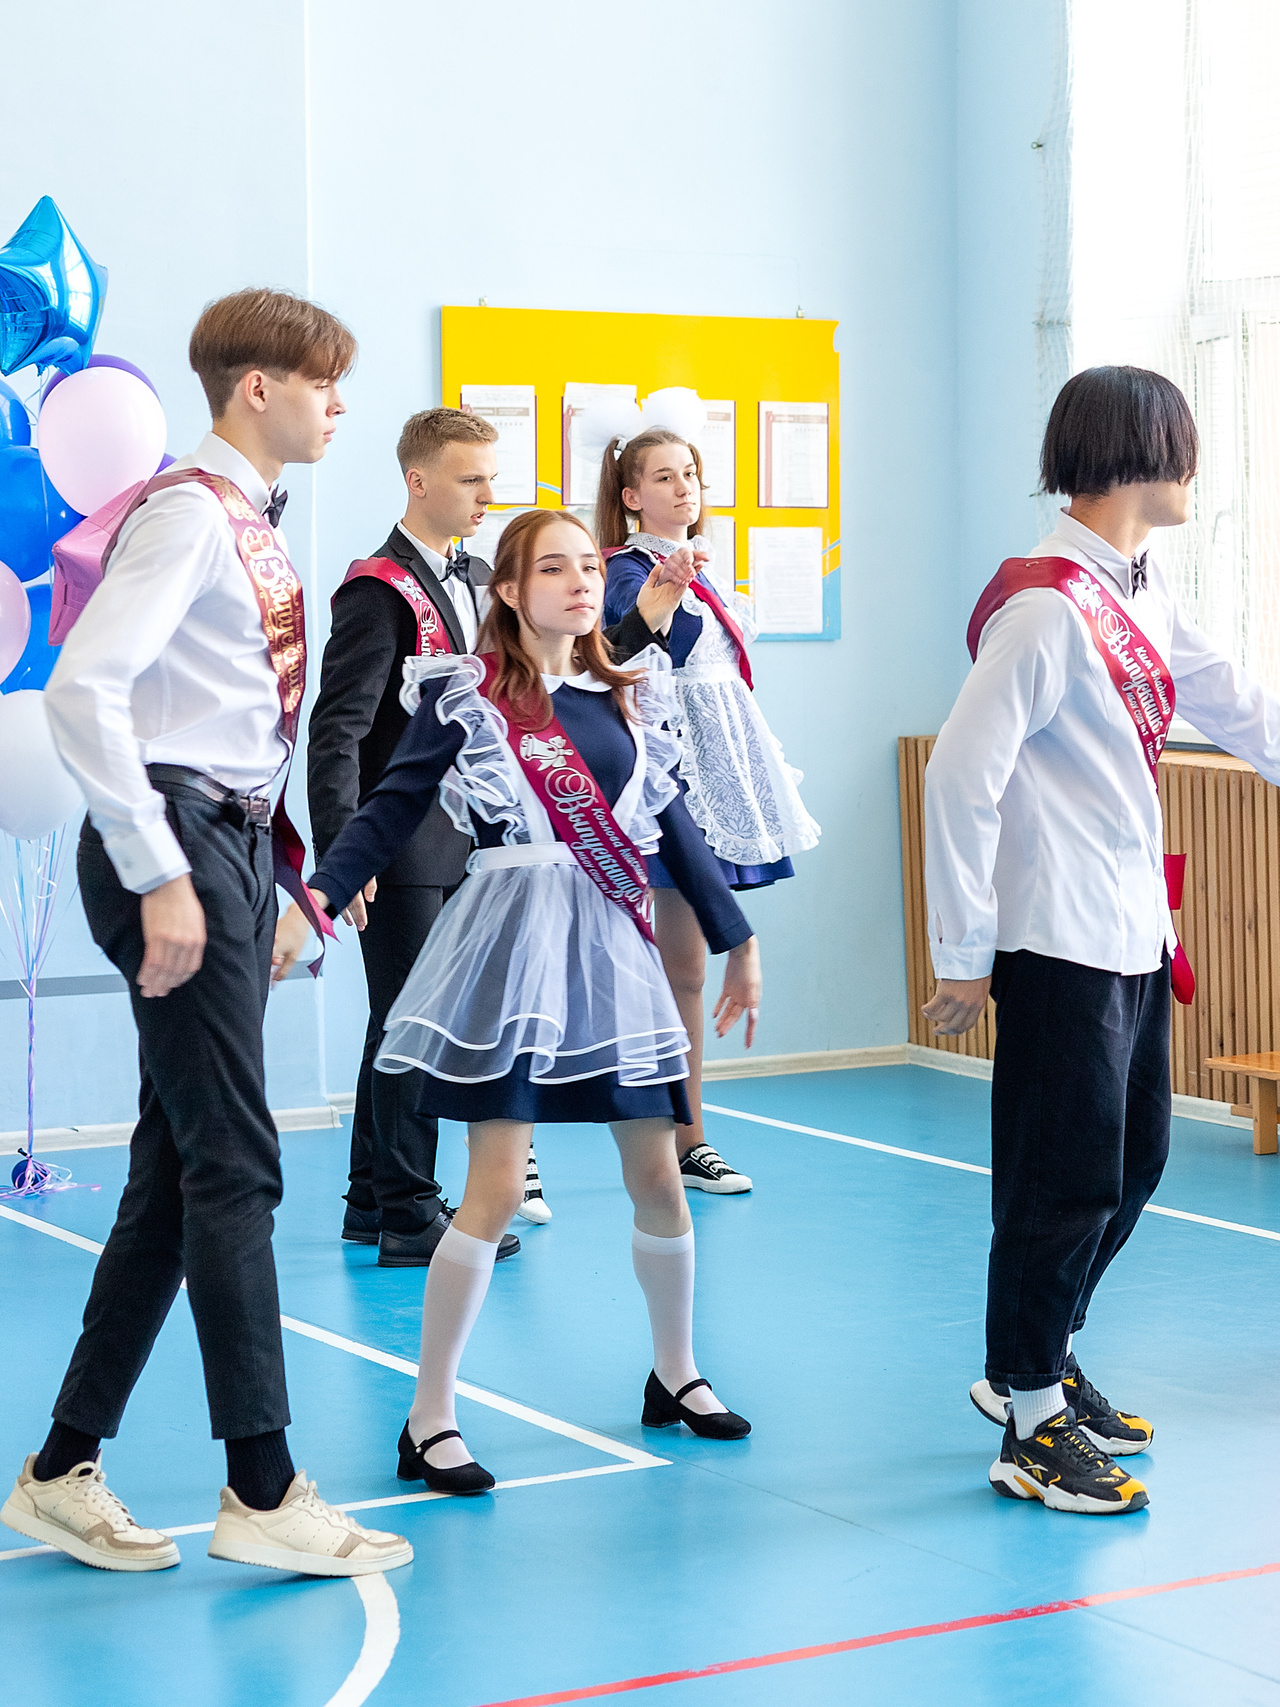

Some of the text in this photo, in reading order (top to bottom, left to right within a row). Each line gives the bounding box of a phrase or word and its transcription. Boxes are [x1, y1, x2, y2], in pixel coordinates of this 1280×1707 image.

[241, 526, 301, 714] Выпускник
[1098, 606, 1163, 733] Выпускник
[1126, 691, 1138, 712] МБОУ
[1134, 646, 1154, 670] Ким
[1151, 668, 1171, 715] Владимир
[545, 767, 643, 902] Выпускница
[591, 808, 624, 847] Козлова
